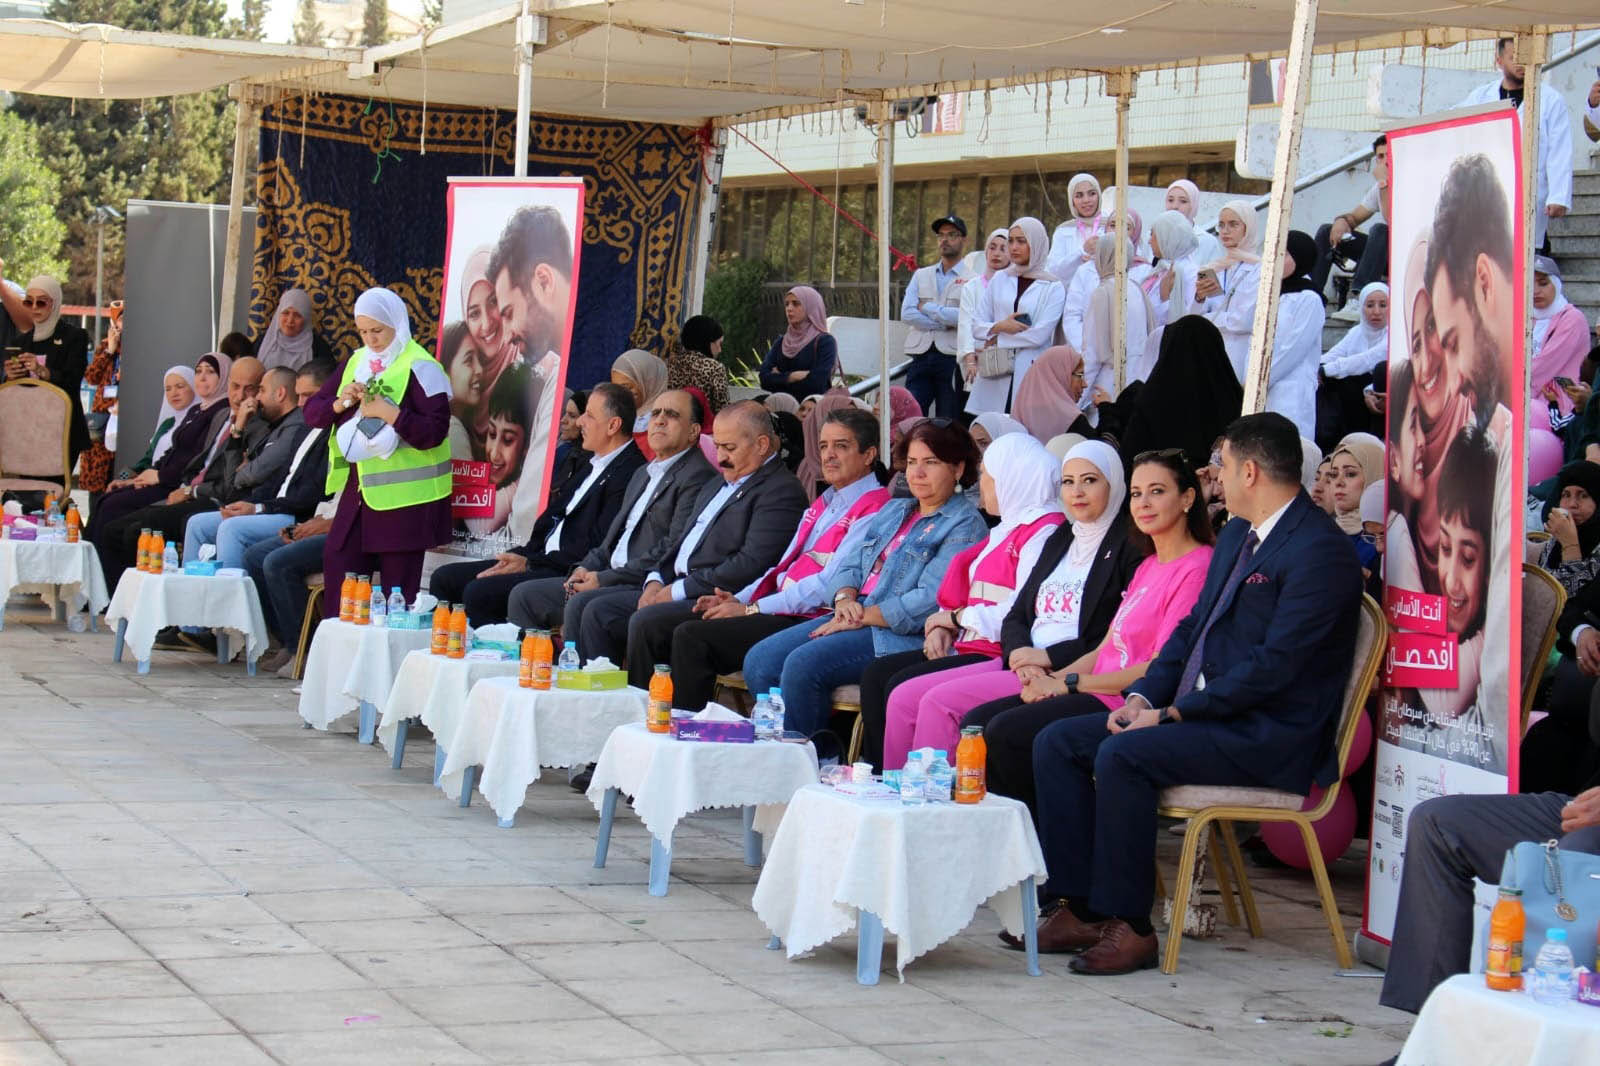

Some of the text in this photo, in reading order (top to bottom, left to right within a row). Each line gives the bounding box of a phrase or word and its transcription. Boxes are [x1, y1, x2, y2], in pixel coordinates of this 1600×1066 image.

[451, 463, 470, 476] الأسا
[451, 488, 493, 507] افحص
[1386, 641, 1454, 683] افحصي
